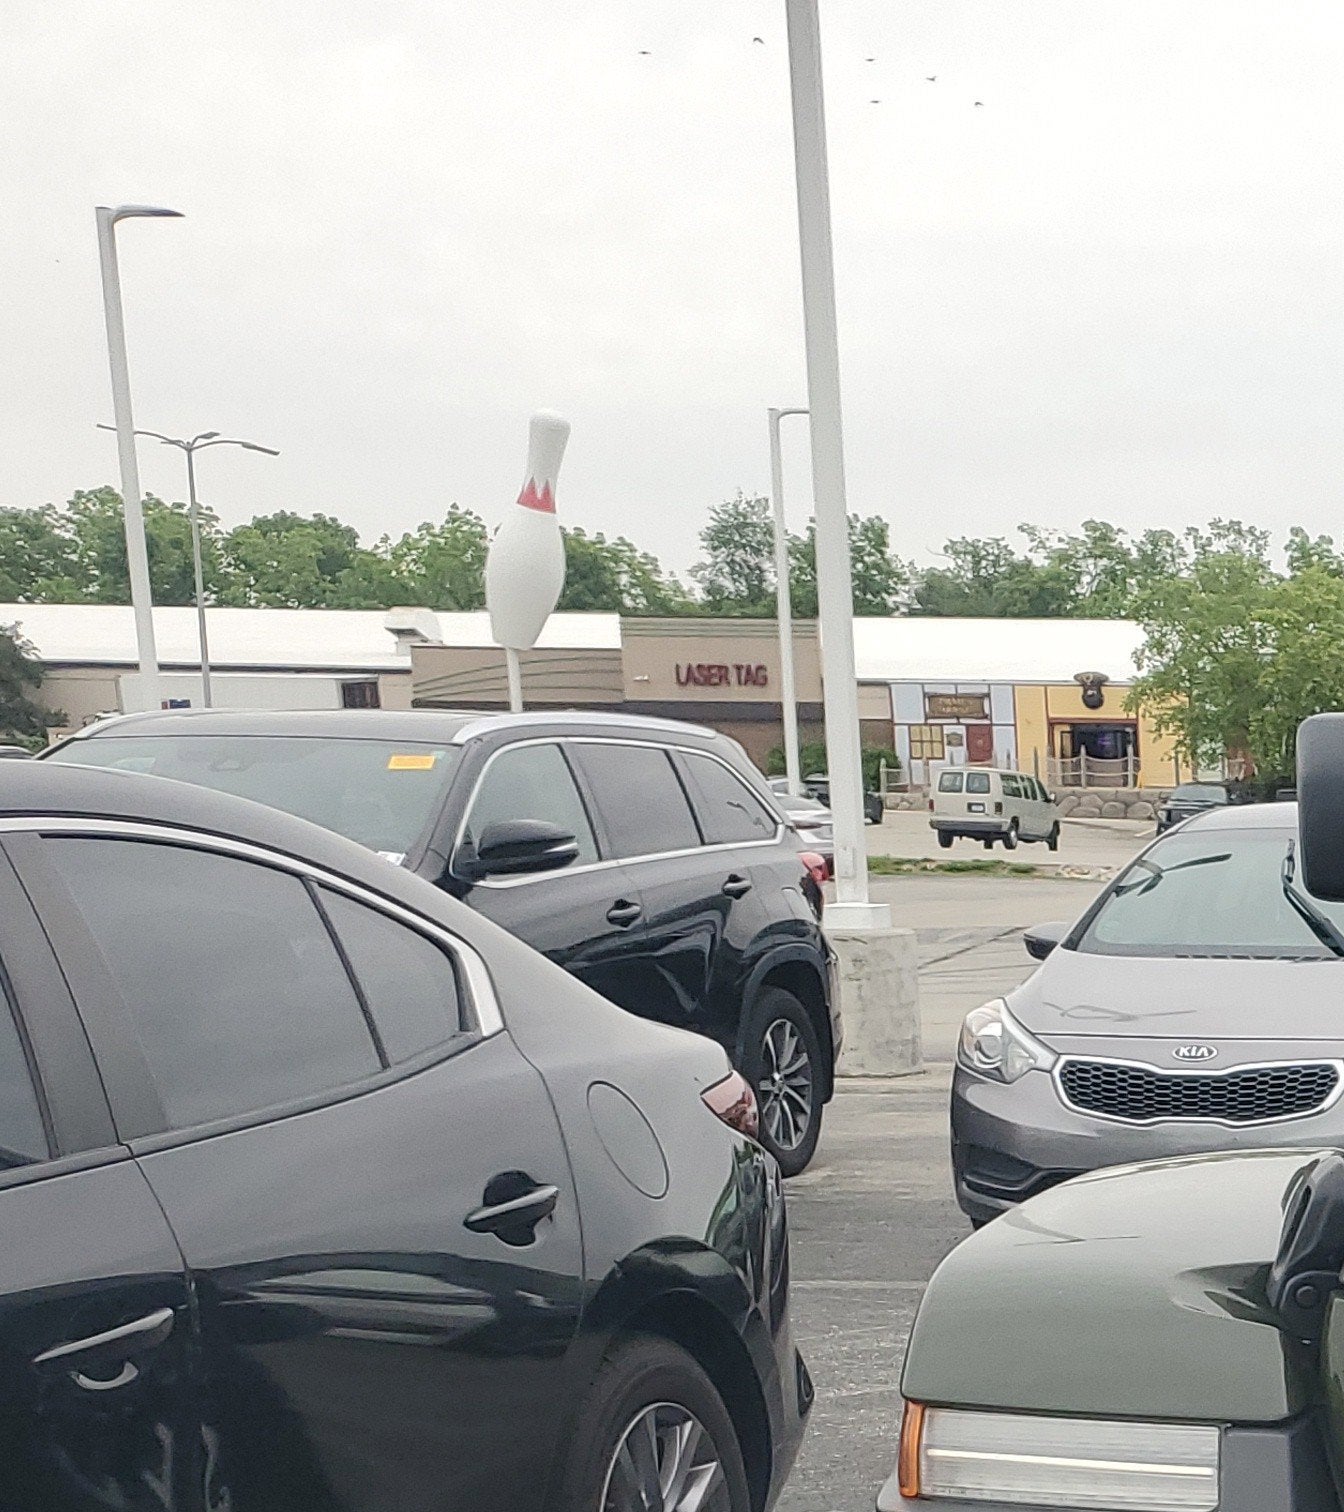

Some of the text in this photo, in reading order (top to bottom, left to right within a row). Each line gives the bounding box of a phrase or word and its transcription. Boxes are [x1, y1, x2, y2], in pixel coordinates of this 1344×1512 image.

[675, 663, 768, 687] LASER TAG
[1179, 1045, 1209, 1057] KIA
